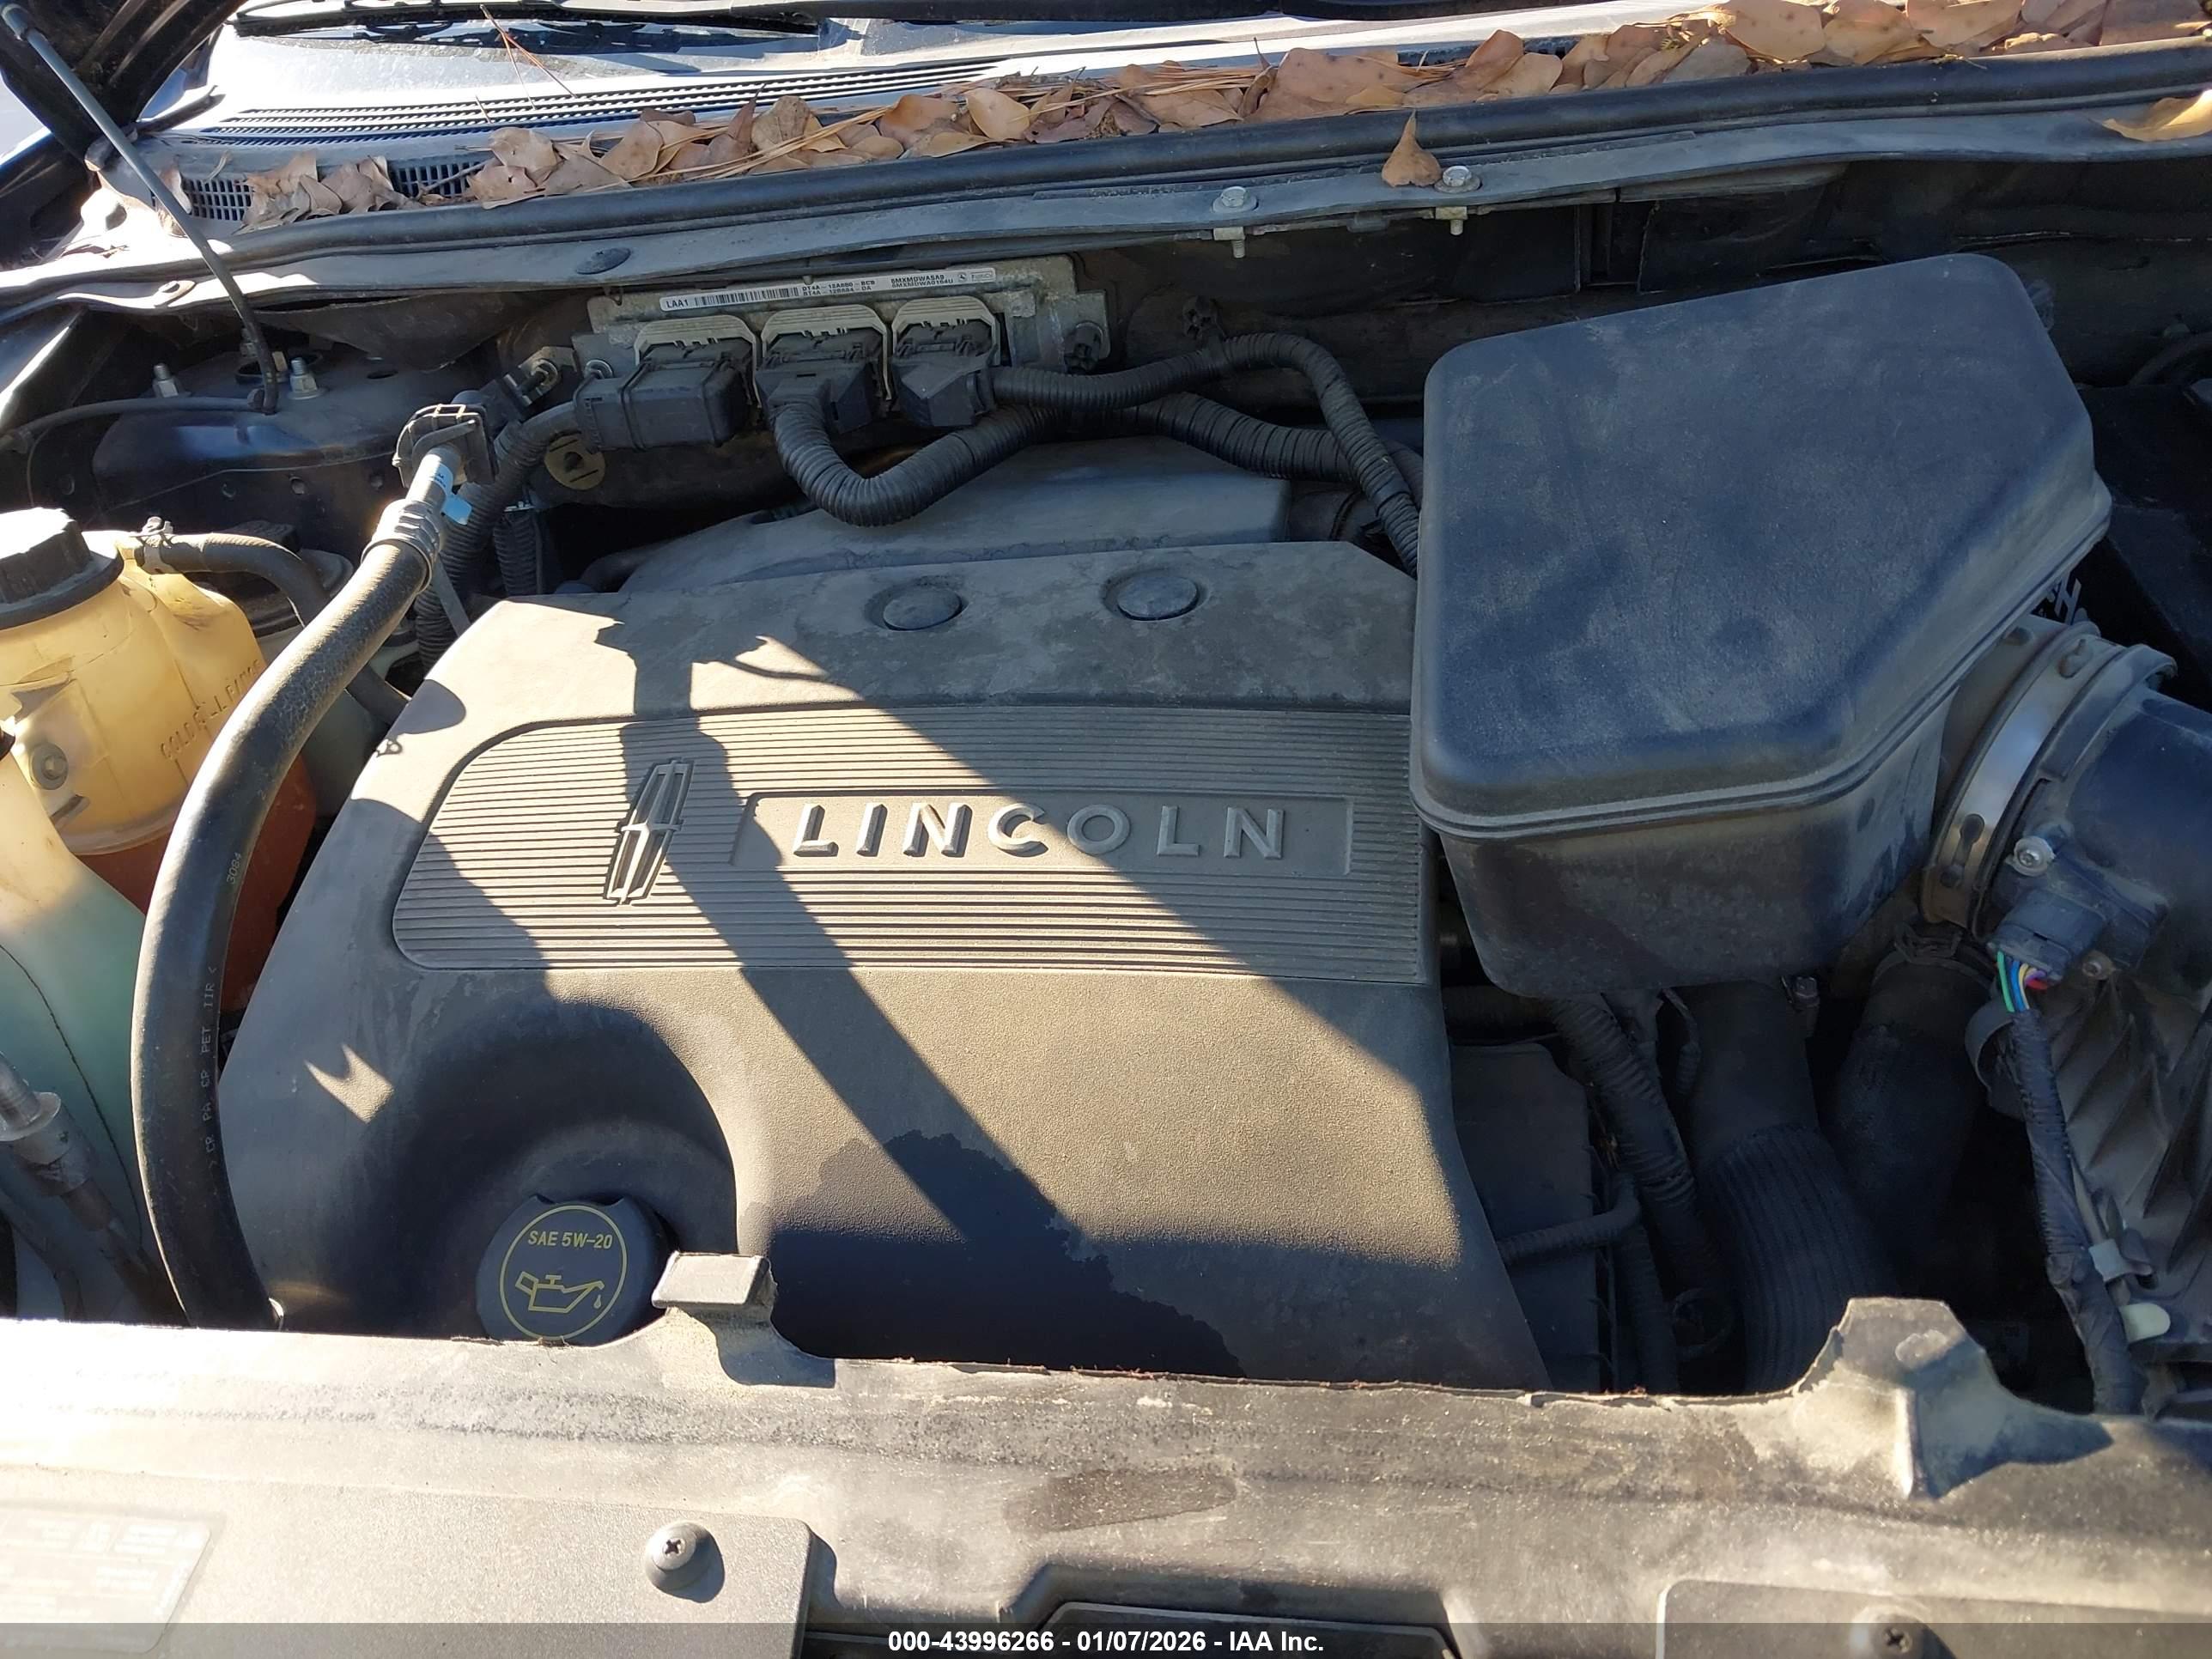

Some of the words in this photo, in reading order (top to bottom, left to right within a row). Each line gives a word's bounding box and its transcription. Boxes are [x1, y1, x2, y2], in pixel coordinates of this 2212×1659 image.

[666, 299, 689, 308] LAA1
[793, 802, 1285, 859] LINCOLN
[226, 852, 241, 884] 3084
[201, 1026, 212, 1054] PET
[528, 1230, 559, 1247] SAE
[562, 1231, 613, 1249] 5W-20
